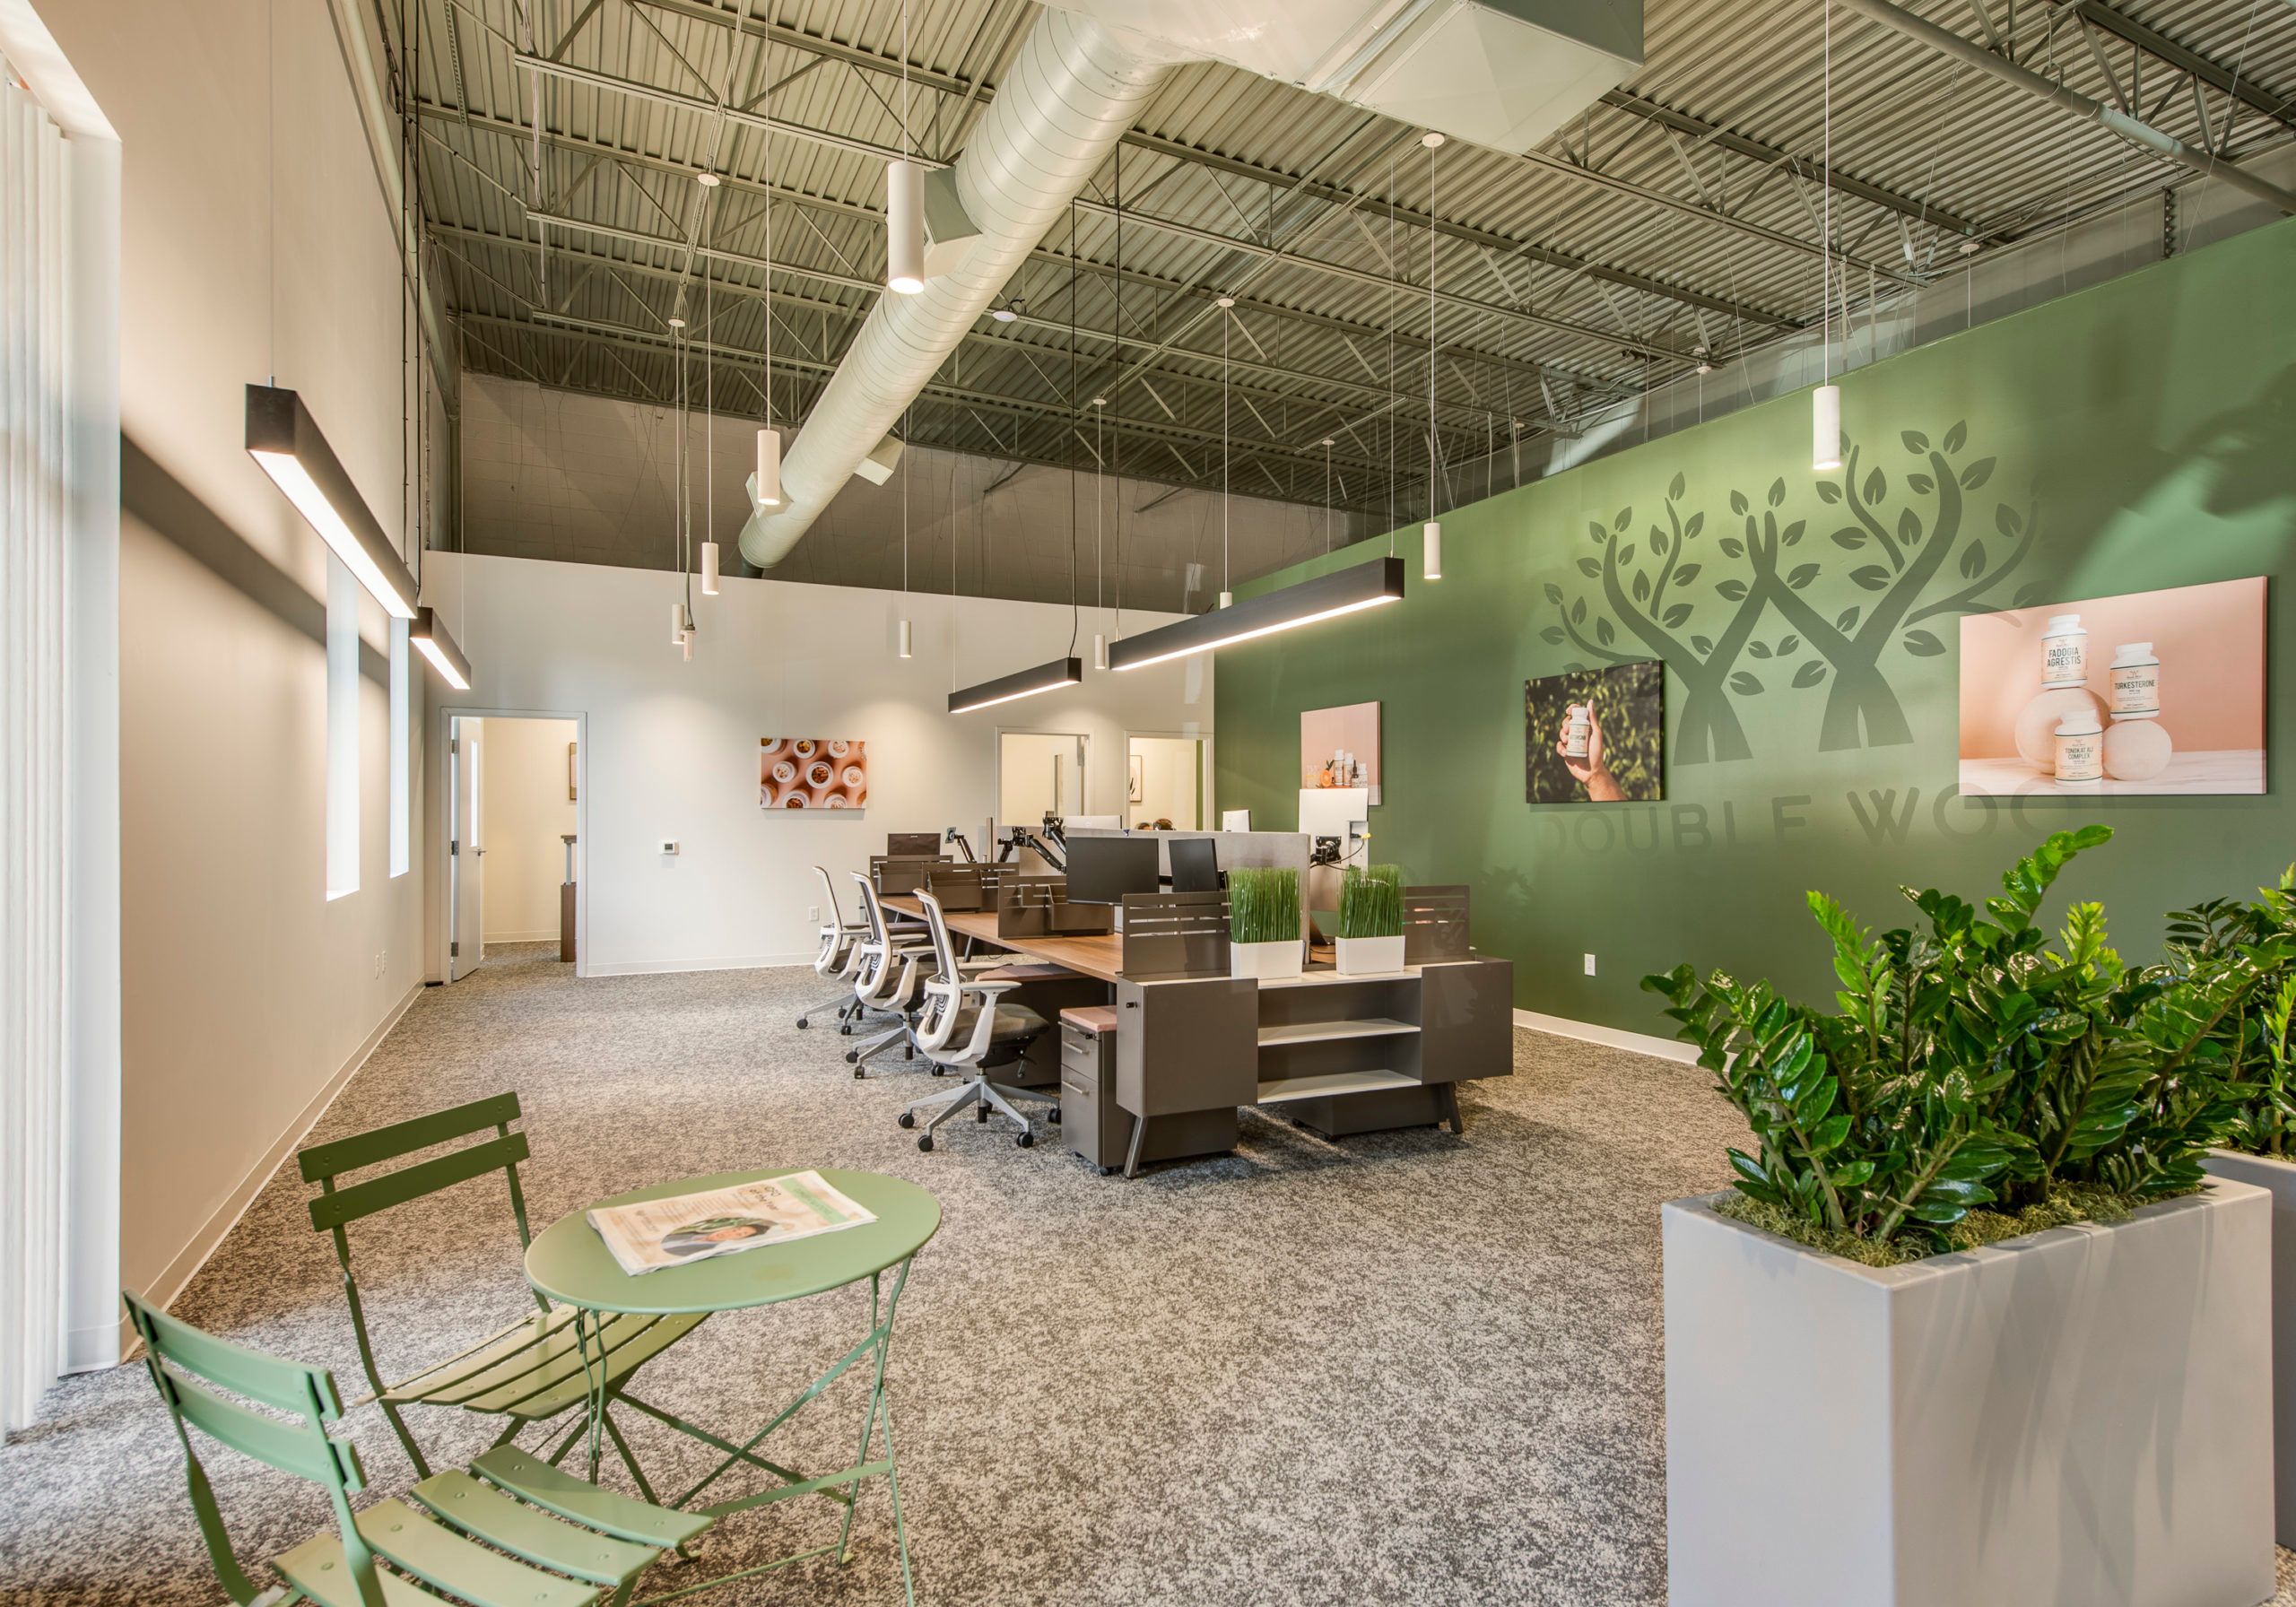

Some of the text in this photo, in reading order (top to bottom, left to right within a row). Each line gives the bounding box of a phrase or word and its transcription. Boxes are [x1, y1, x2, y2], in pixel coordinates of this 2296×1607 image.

[2048, 647, 2079, 658] FADOGIA
[2047, 656, 2081, 667] AGRESTIS
[2114, 679, 2154, 690] TURKESTERONE
